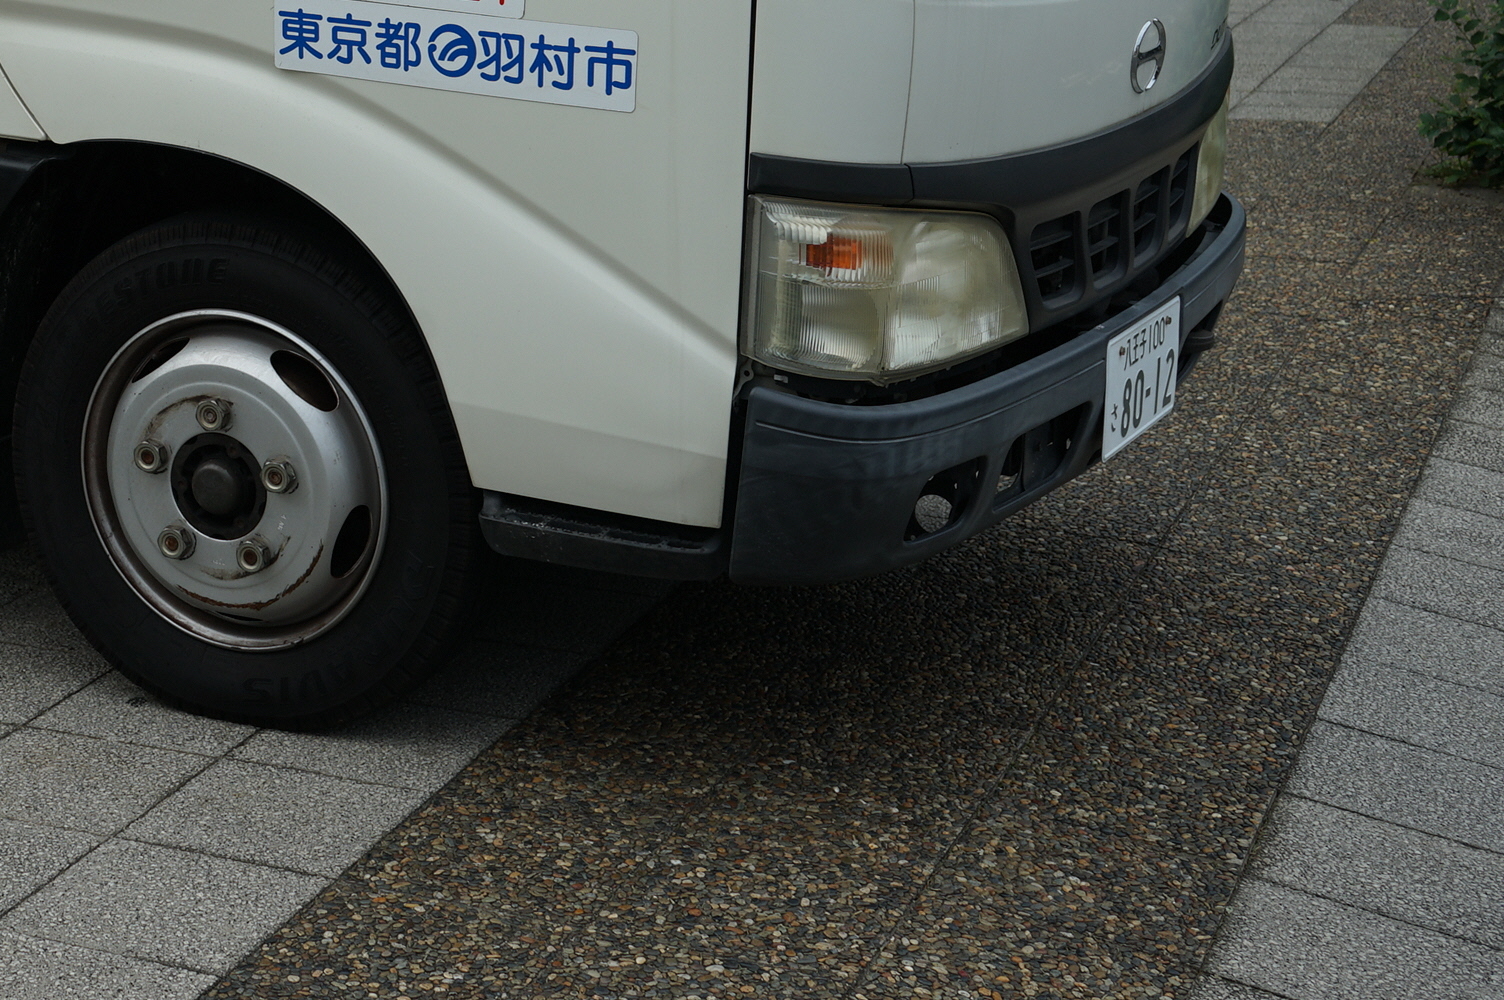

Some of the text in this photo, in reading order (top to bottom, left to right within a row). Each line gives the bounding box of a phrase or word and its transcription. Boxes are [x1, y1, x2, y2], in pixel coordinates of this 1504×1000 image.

[278, 8, 637, 96] 東京都 羽村市
[1120, 348, 1176, 438] 80-12
